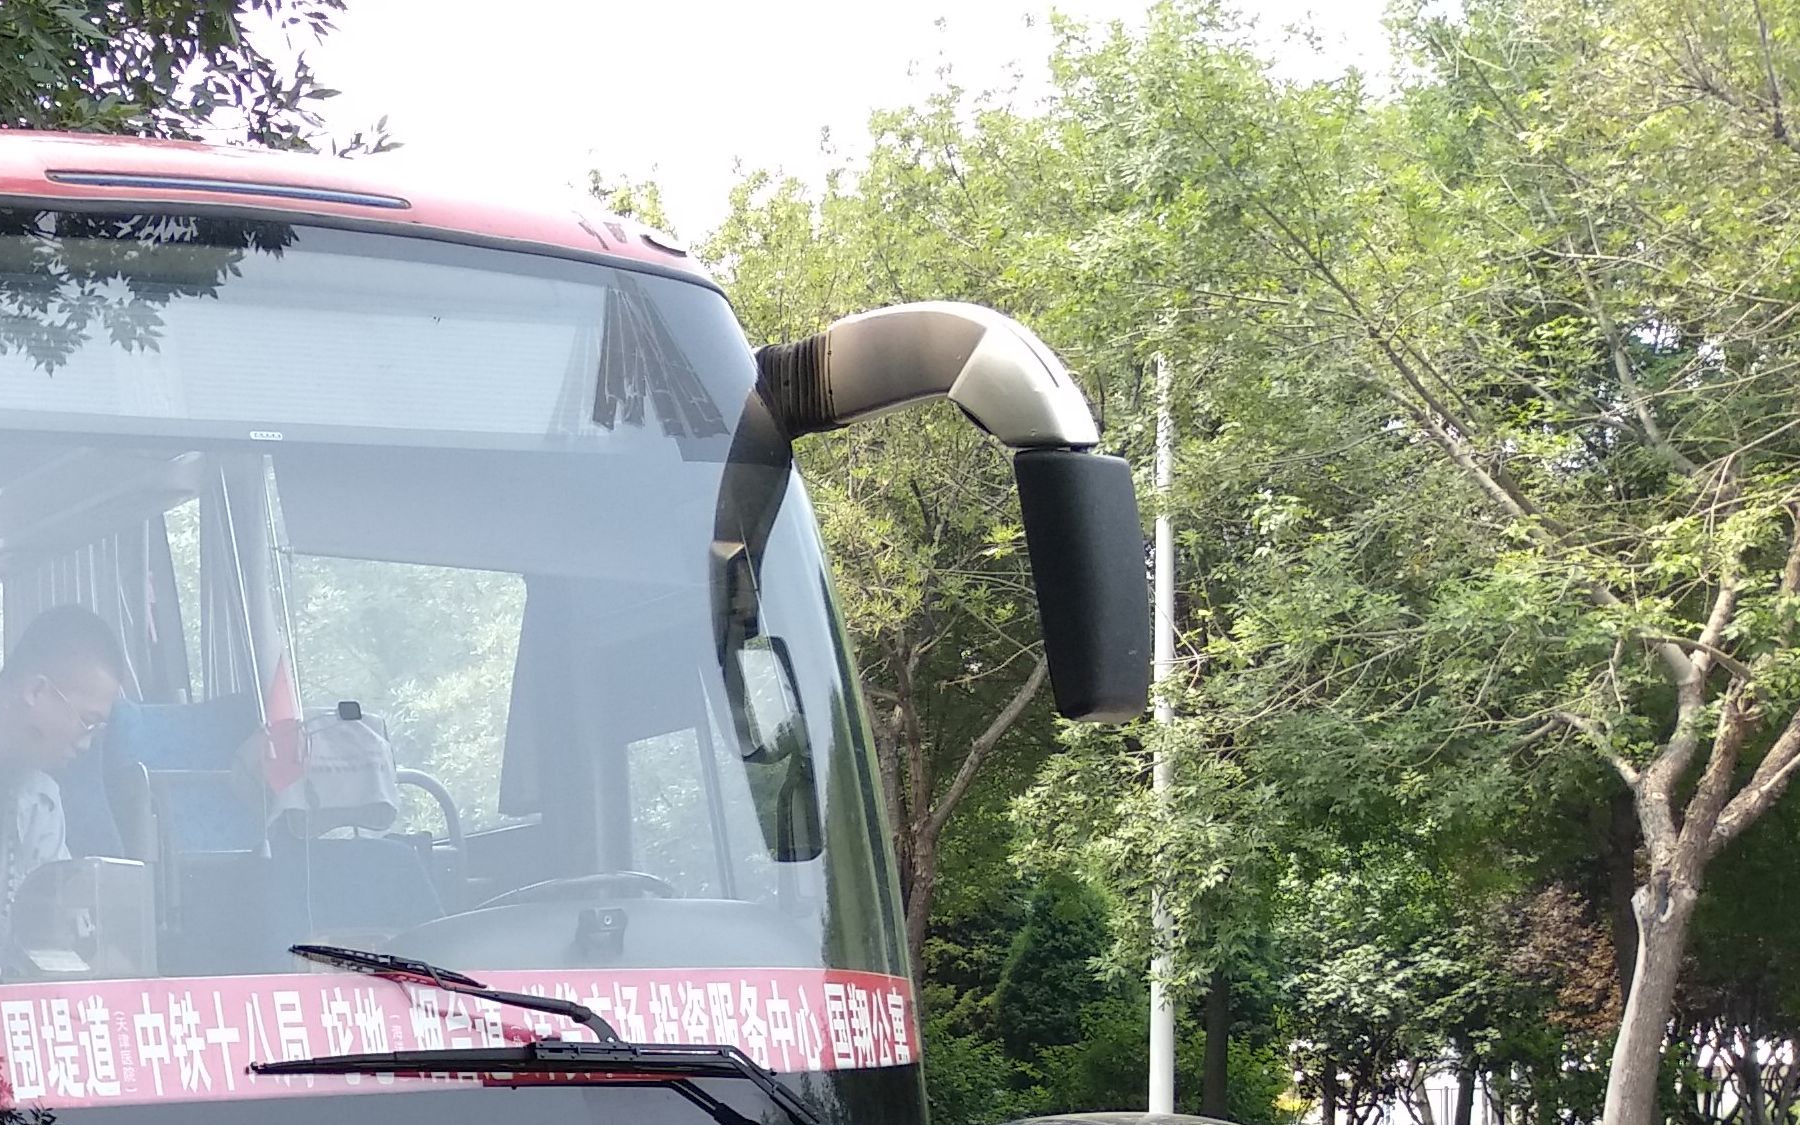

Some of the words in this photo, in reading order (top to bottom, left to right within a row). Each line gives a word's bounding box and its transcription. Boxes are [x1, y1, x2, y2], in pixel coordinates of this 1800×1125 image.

[2, 994, 121, 1101] 围堤道
[132, 989, 315, 1097] 中铁十八局
[824, 982, 911, 1069] 国翔公寓
